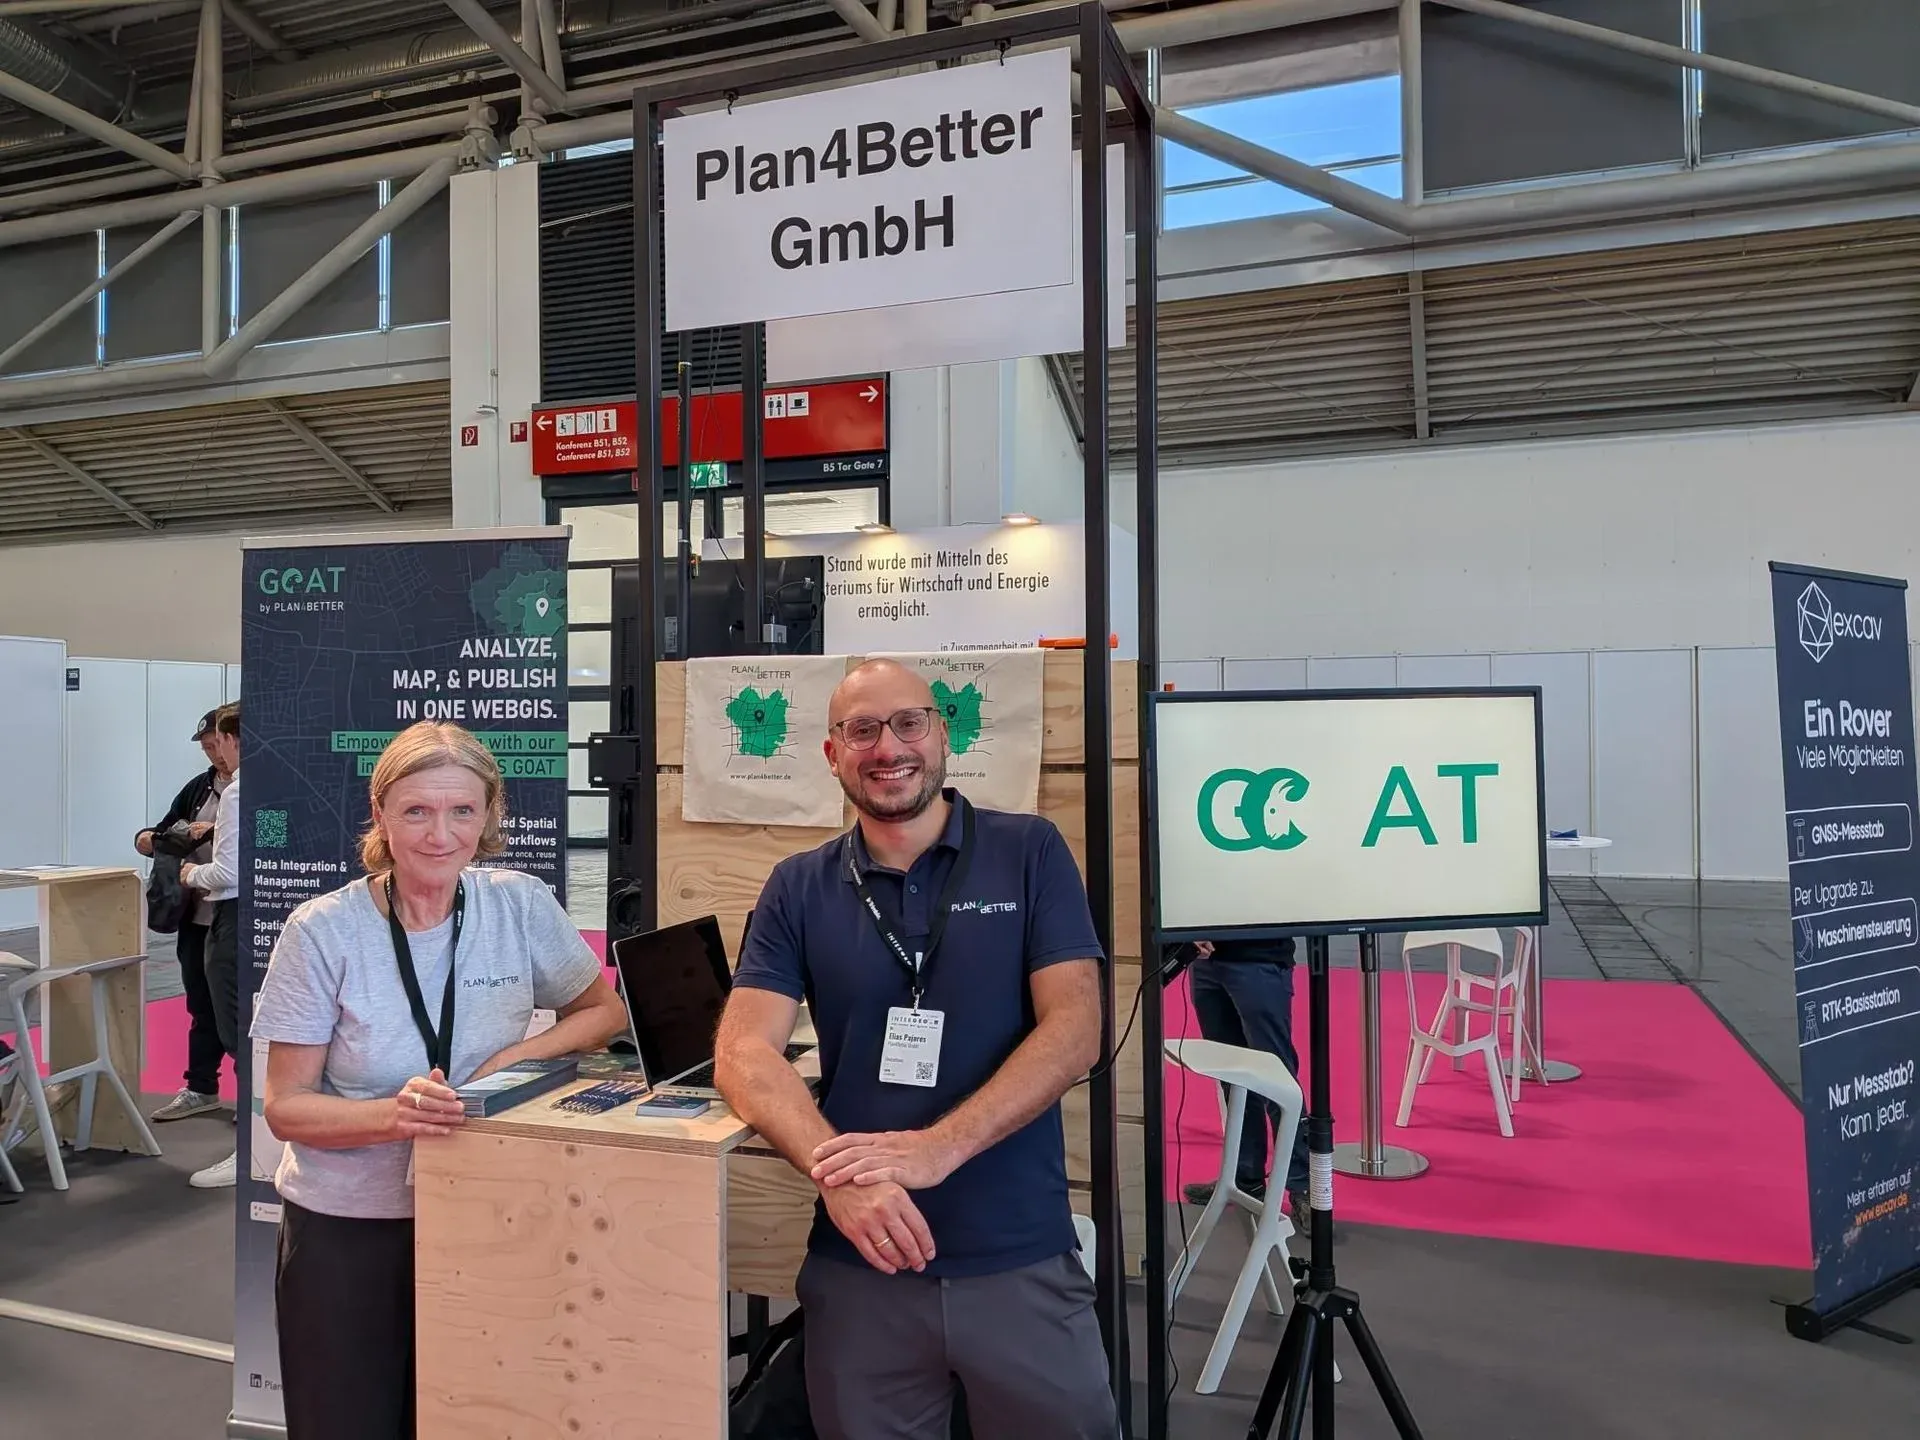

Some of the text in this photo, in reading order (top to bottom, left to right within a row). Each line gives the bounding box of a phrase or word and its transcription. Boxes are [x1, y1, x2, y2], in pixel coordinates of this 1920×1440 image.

[697, 106, 1043, 201] Plan4Better
[771, 194, 954, 270] GmbH
[556, 437, 627, 450] Konferenz B51, B52
[556, 448, 630, 461] Conference B51, B52
[823, 459, 883, 472] B5 Tor Gate 7
[827, 547, 1008, 572] Stand wurde mit Mitteln des
[260, 566, 346, 594] GOAT
[825, 571, 1050, 596] teriums für Wirtschaft und Energie
[260, 603, 271, 614] by
[858, 598, 930, 621] ermöglicht.
[1833, 611, 1882, 641] excav
[459, 637, 557, 660] ANALYZE,
[392, 668, 557, 692] MAP, & PUBLISH
[396, 698, 557, 719] IN ONE WEBGIS.
[1804, 698, 1893, 738] Ein Rover
[336, 733, 393, 754] Empow
[488, 733, 524, 749] with
[528, 737, 555, 749] our
[512, 758, 556, 775] GOAT
[1796, 744, 1904, 775] Viele Möglichkeiten
[498, 817, 557, 831] ted Spatial
[1811, 820, 1885, 845] GNSS-Messstab
[254, 858, 347, 873] Data Integration &
[481, 861, 528, 869] reproducible
[529, 861, 557, 870] results.
[254, 874, 320, 889] Management
[1794, 886, 1812, 907] Per
[1814, 879, 1858, 907] Upgrade
[253, 889, 272, 899] Bring
[282, 891, 309, 899] connect
[253, 900, 270, 908] from
[253, 919, 285, 932] Spatia
[1817, 917, 1911, 949] Maschinensteuerung
[253, 935, 271, 946] GIS
[253, 950, 268, 958] Turn
[1821, 987, 1901, 1023] RTK-Basisstation
[1828, 1059, 1914, 1110] Nur Messstab?
[1840, 1098, 1909, 1141] Kann jeder.
[1847, 1168, 1912, 1210] Mehr erfahren auf
[1855, 1192, 1909, 1227] www.excav.de
